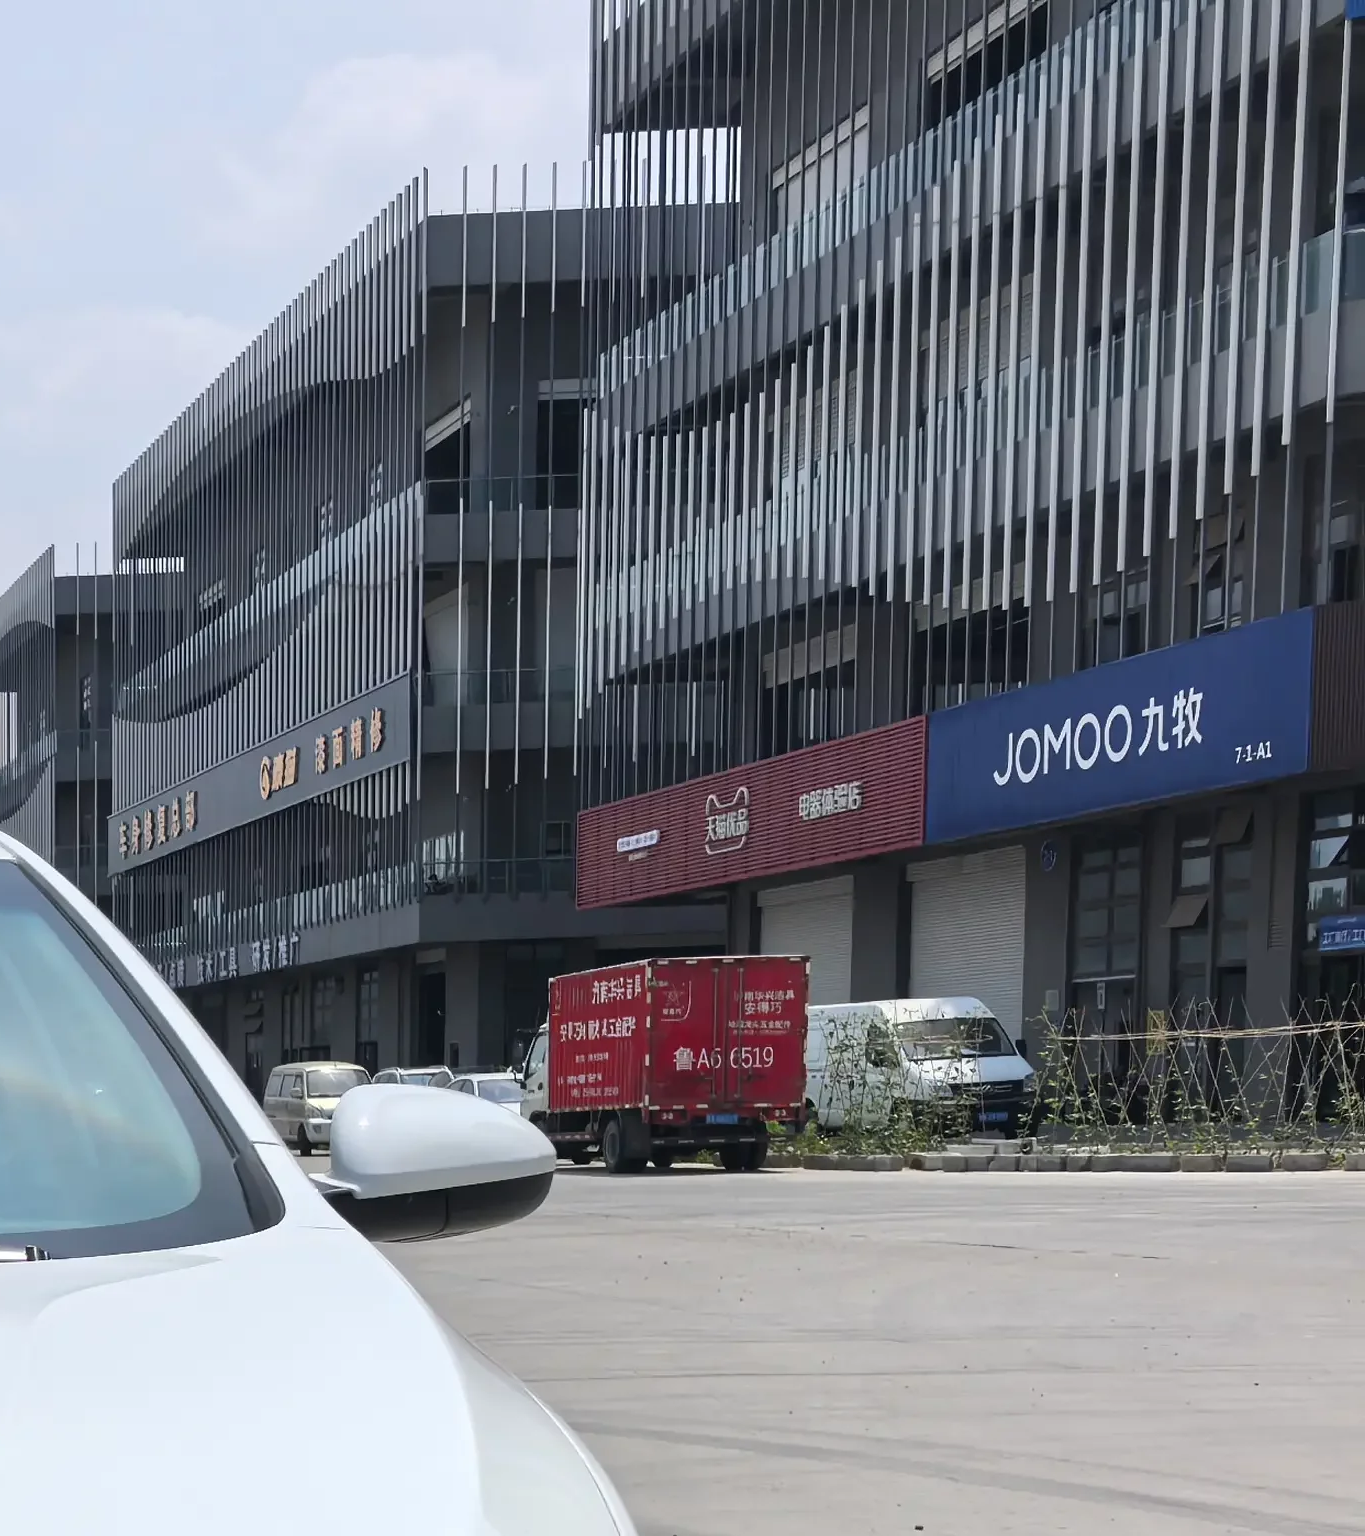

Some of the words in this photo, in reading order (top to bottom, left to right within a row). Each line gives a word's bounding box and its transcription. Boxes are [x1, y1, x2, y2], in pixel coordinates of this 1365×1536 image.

[993, 704, 1133, 786] JOMOO
[1138, 687, 1204, 757] 九牧
[1234, 741, 1273, 765] 7-1-A1
[705, 808, 750, 842] 天猫优品
